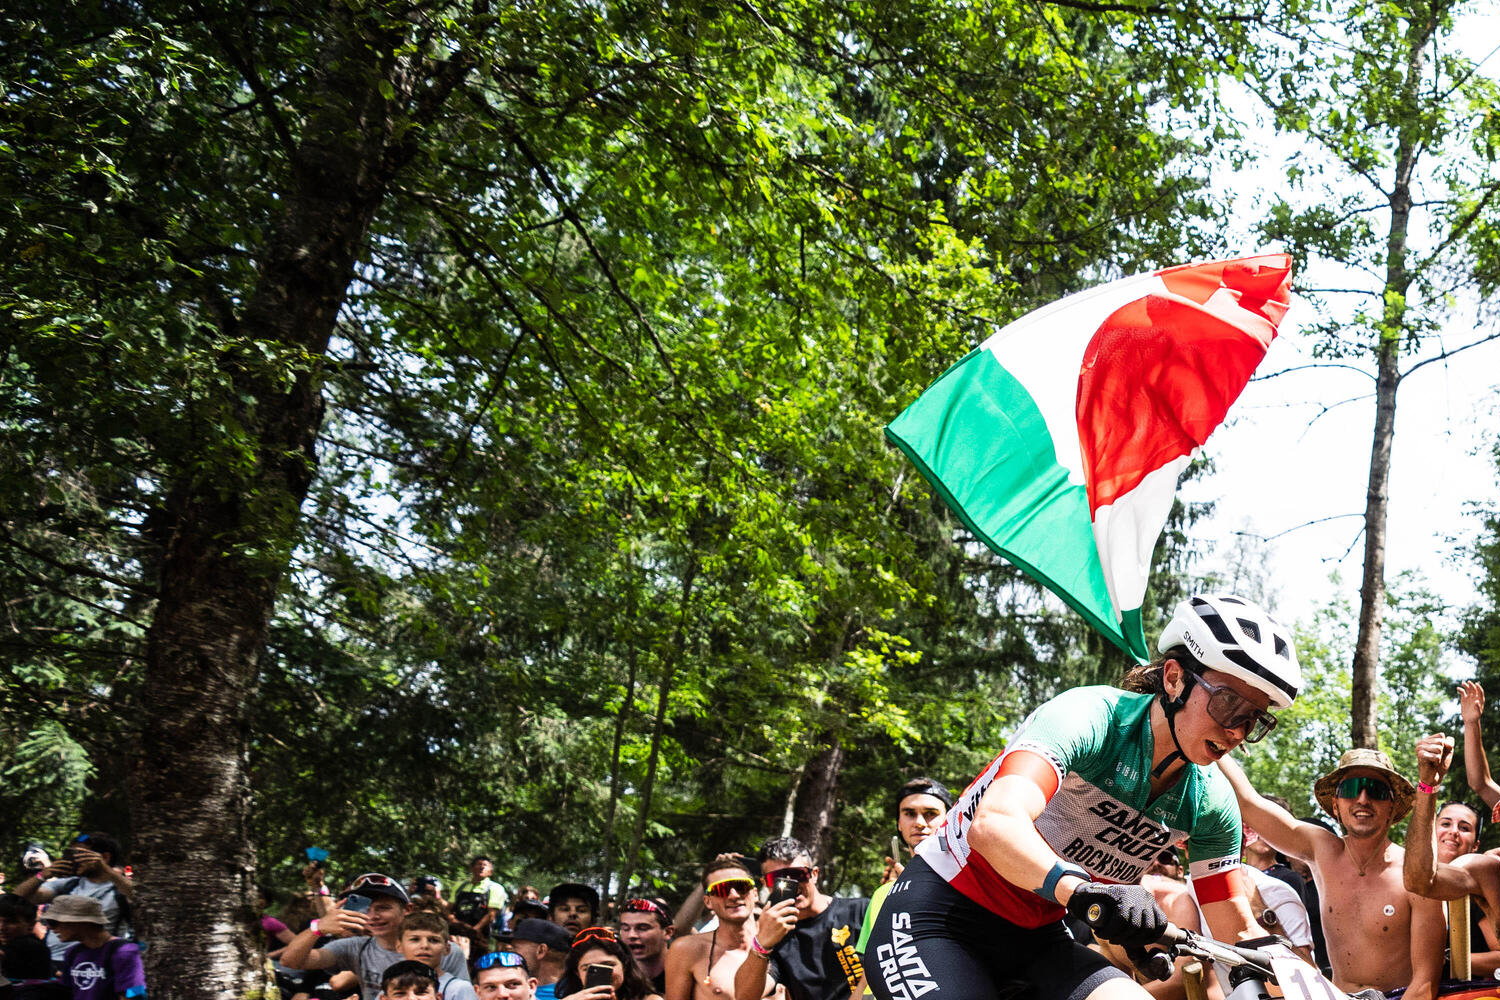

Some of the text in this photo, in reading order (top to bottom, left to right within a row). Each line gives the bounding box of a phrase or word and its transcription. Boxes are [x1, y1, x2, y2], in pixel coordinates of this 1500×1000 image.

[1184, 631, 1204, 658] SMITH
[1089, 800, 1172, 846] SANTA
[1153, 807, 1178, 822] SMITH
[1062, 837, 1144, 882] ROCKSHOX
[1095, 827, 1161, 861] CRUZ
[892, 912, 939, 999] SANTA
